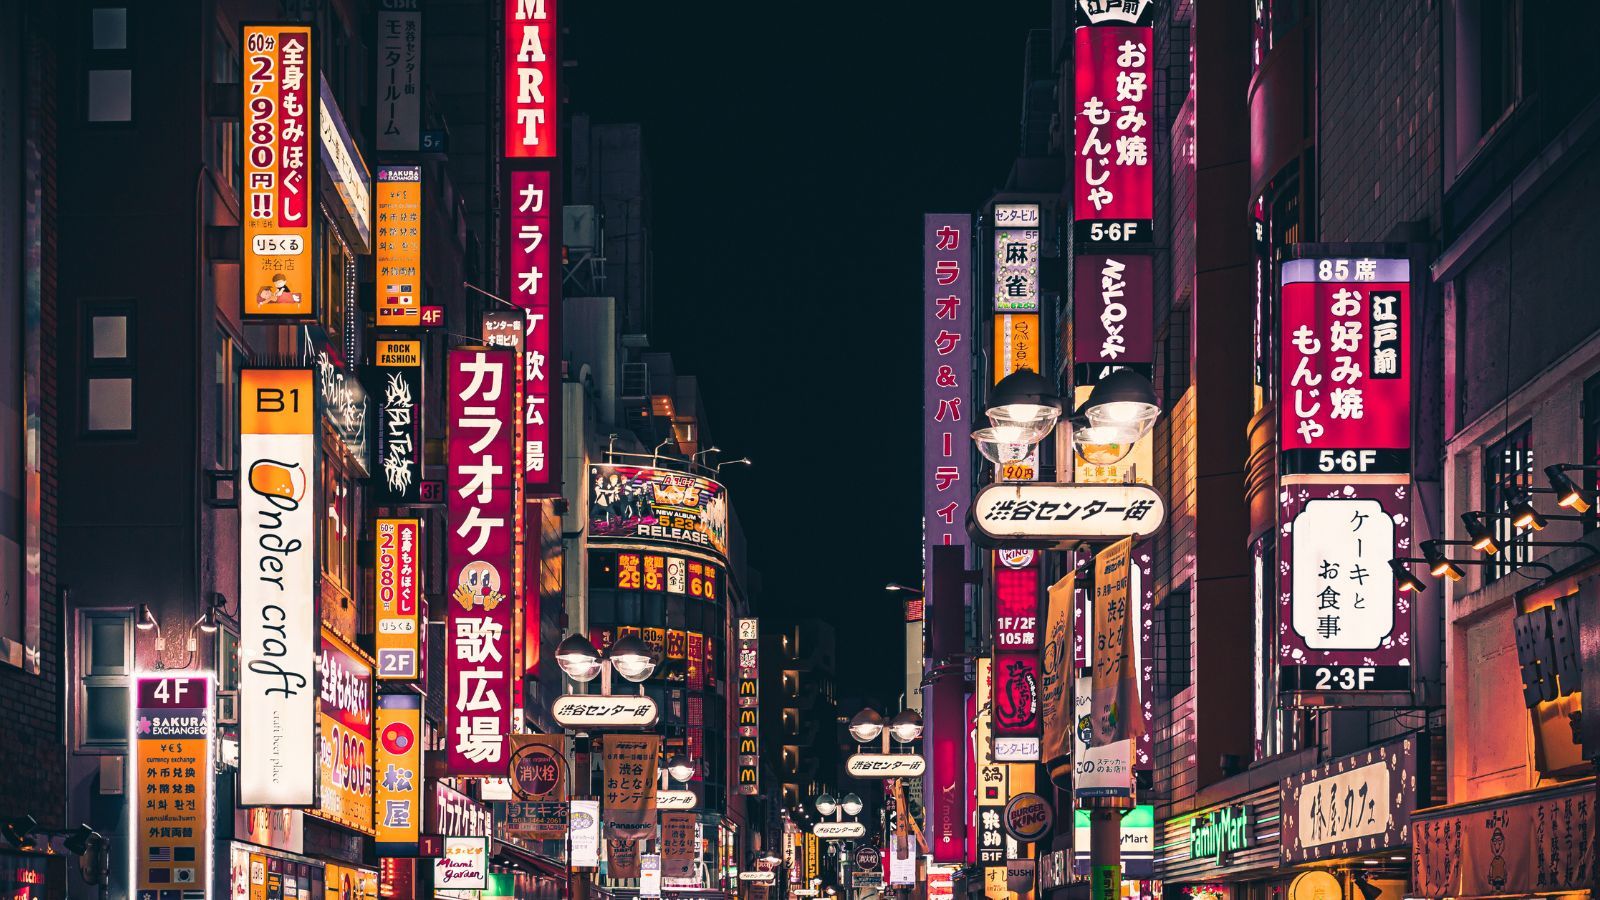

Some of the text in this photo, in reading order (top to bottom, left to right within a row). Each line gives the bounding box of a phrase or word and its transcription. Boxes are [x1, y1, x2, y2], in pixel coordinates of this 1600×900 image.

[247, 34, 276, 53] 60分
[385, 19, 401, 136] モニタールーム
[515, 0, 547, 146] MART
[1116, 41, 1148, 167] お好み焼
[281, 38, 305, 223] 全身もみほぐし
[1083, 97, 1114, 211] もんじゃ
[996, 209, 1038, 222] センタービル
[1025, 231, 1038, 240] 5F
[256, 239, 301, 252] りらくる
[261, 259, 296, 273] 渋谷店
[1005, 242, 1028, 298] 麻雀
[423, 310, 441, 323] 4F
[486, 320, 521, 331] センター街
[1373, 296, 1398, 375] 江戸前
[388, 344, 410, 353] ROCK
[1330, 288, 1364, 420] お好み焼
[381, 354, 417, 364] FASHION
[1290, 325, 1325, 444] もんじゃ
[256, 388, 299, 413] B1
[656, 509, 696, 520] NEW ALBUM
[985, 499, 1155, 521] 渋谷センター街
[659, 516, 695, 531] 5.23
[637, 525, 709, 545] RELEASE
[455, 352, 505, 764] カラオケ 歌広場
[1006, 548, 1029, 563] KING
[1350, 510, 1370, 610] ケーキと
[401, 528, 414, 612] 全身もみほぐし
[1316, 559, 1342, 639] お食事
[998, 617, 1036, 631] 1F/2F
[999, 633, 1035, 645] 105席
[248, 605, 307, 698] craft
[385, 655, 411, 671] 2F
[154, 678, 190, 705] 4F
[320, 648, 371, 727] 全身もみほぐし
[558, 703, 652, 717] 渋谷センター街
[153, 717, 208, 727] SAKURA
[153, 726, 200, 735] EXCHANGE
[996, 741, 1038, 756] センタービル
[171, 756, 196, 765] exchange
[852, 760, 922, 771] 渋谷センター街
[520, 765, 557, 782] 消火栓
[619, 763, 643, 777] 渋谷
[982, 766, 1003, 782] 鍋
[607, 777, 653, 790] おとなり
[382, 764, 414, 828] 松屋
[607, 791, 654, 804] サンデー
[1011, 804, 1045, 823] BURGER
[610, 820, 652, 830] Panasonic
[1012, 813, 1047, 833] KING
[1190, 814, 1248, 866] FamilyMart
[982, 853, 1003, 862] B1F
[436, 860, 470, 873] Miami
[1008, 869, 1035, 877] SUSHI
